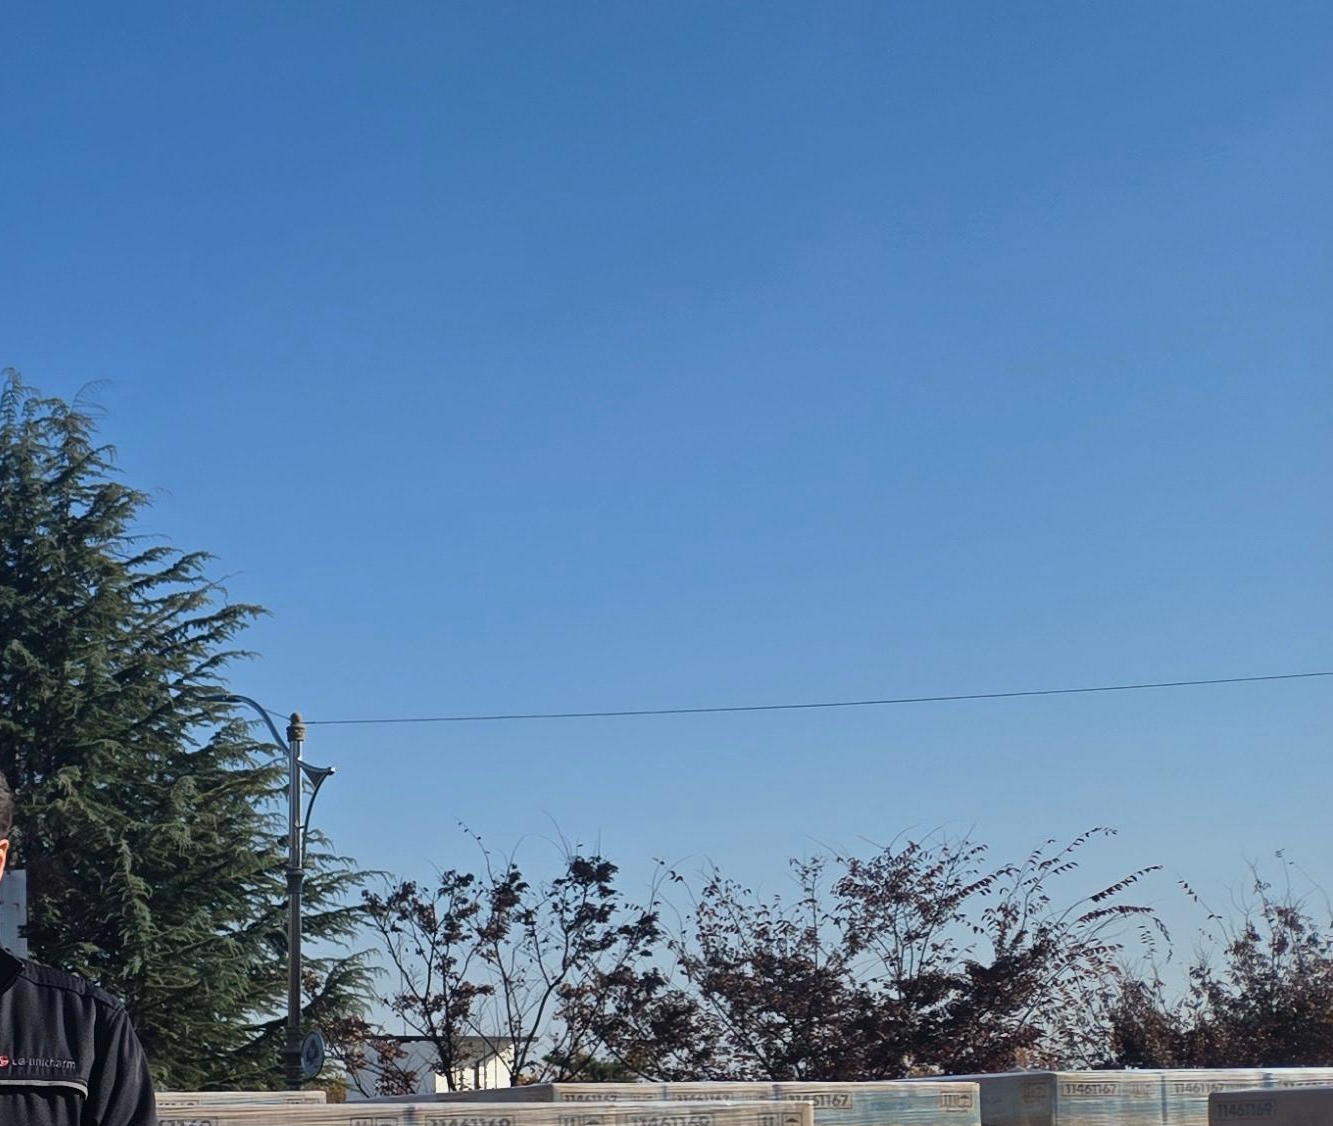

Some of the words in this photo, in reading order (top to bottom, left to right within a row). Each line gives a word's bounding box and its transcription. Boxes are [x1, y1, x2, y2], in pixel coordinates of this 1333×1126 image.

[12, 1057, 76, 1071] LG-unicharm
[1066, 1084, 1117, 1094] 11461167
[1217, 1103, 1273, 1117] 11461169
